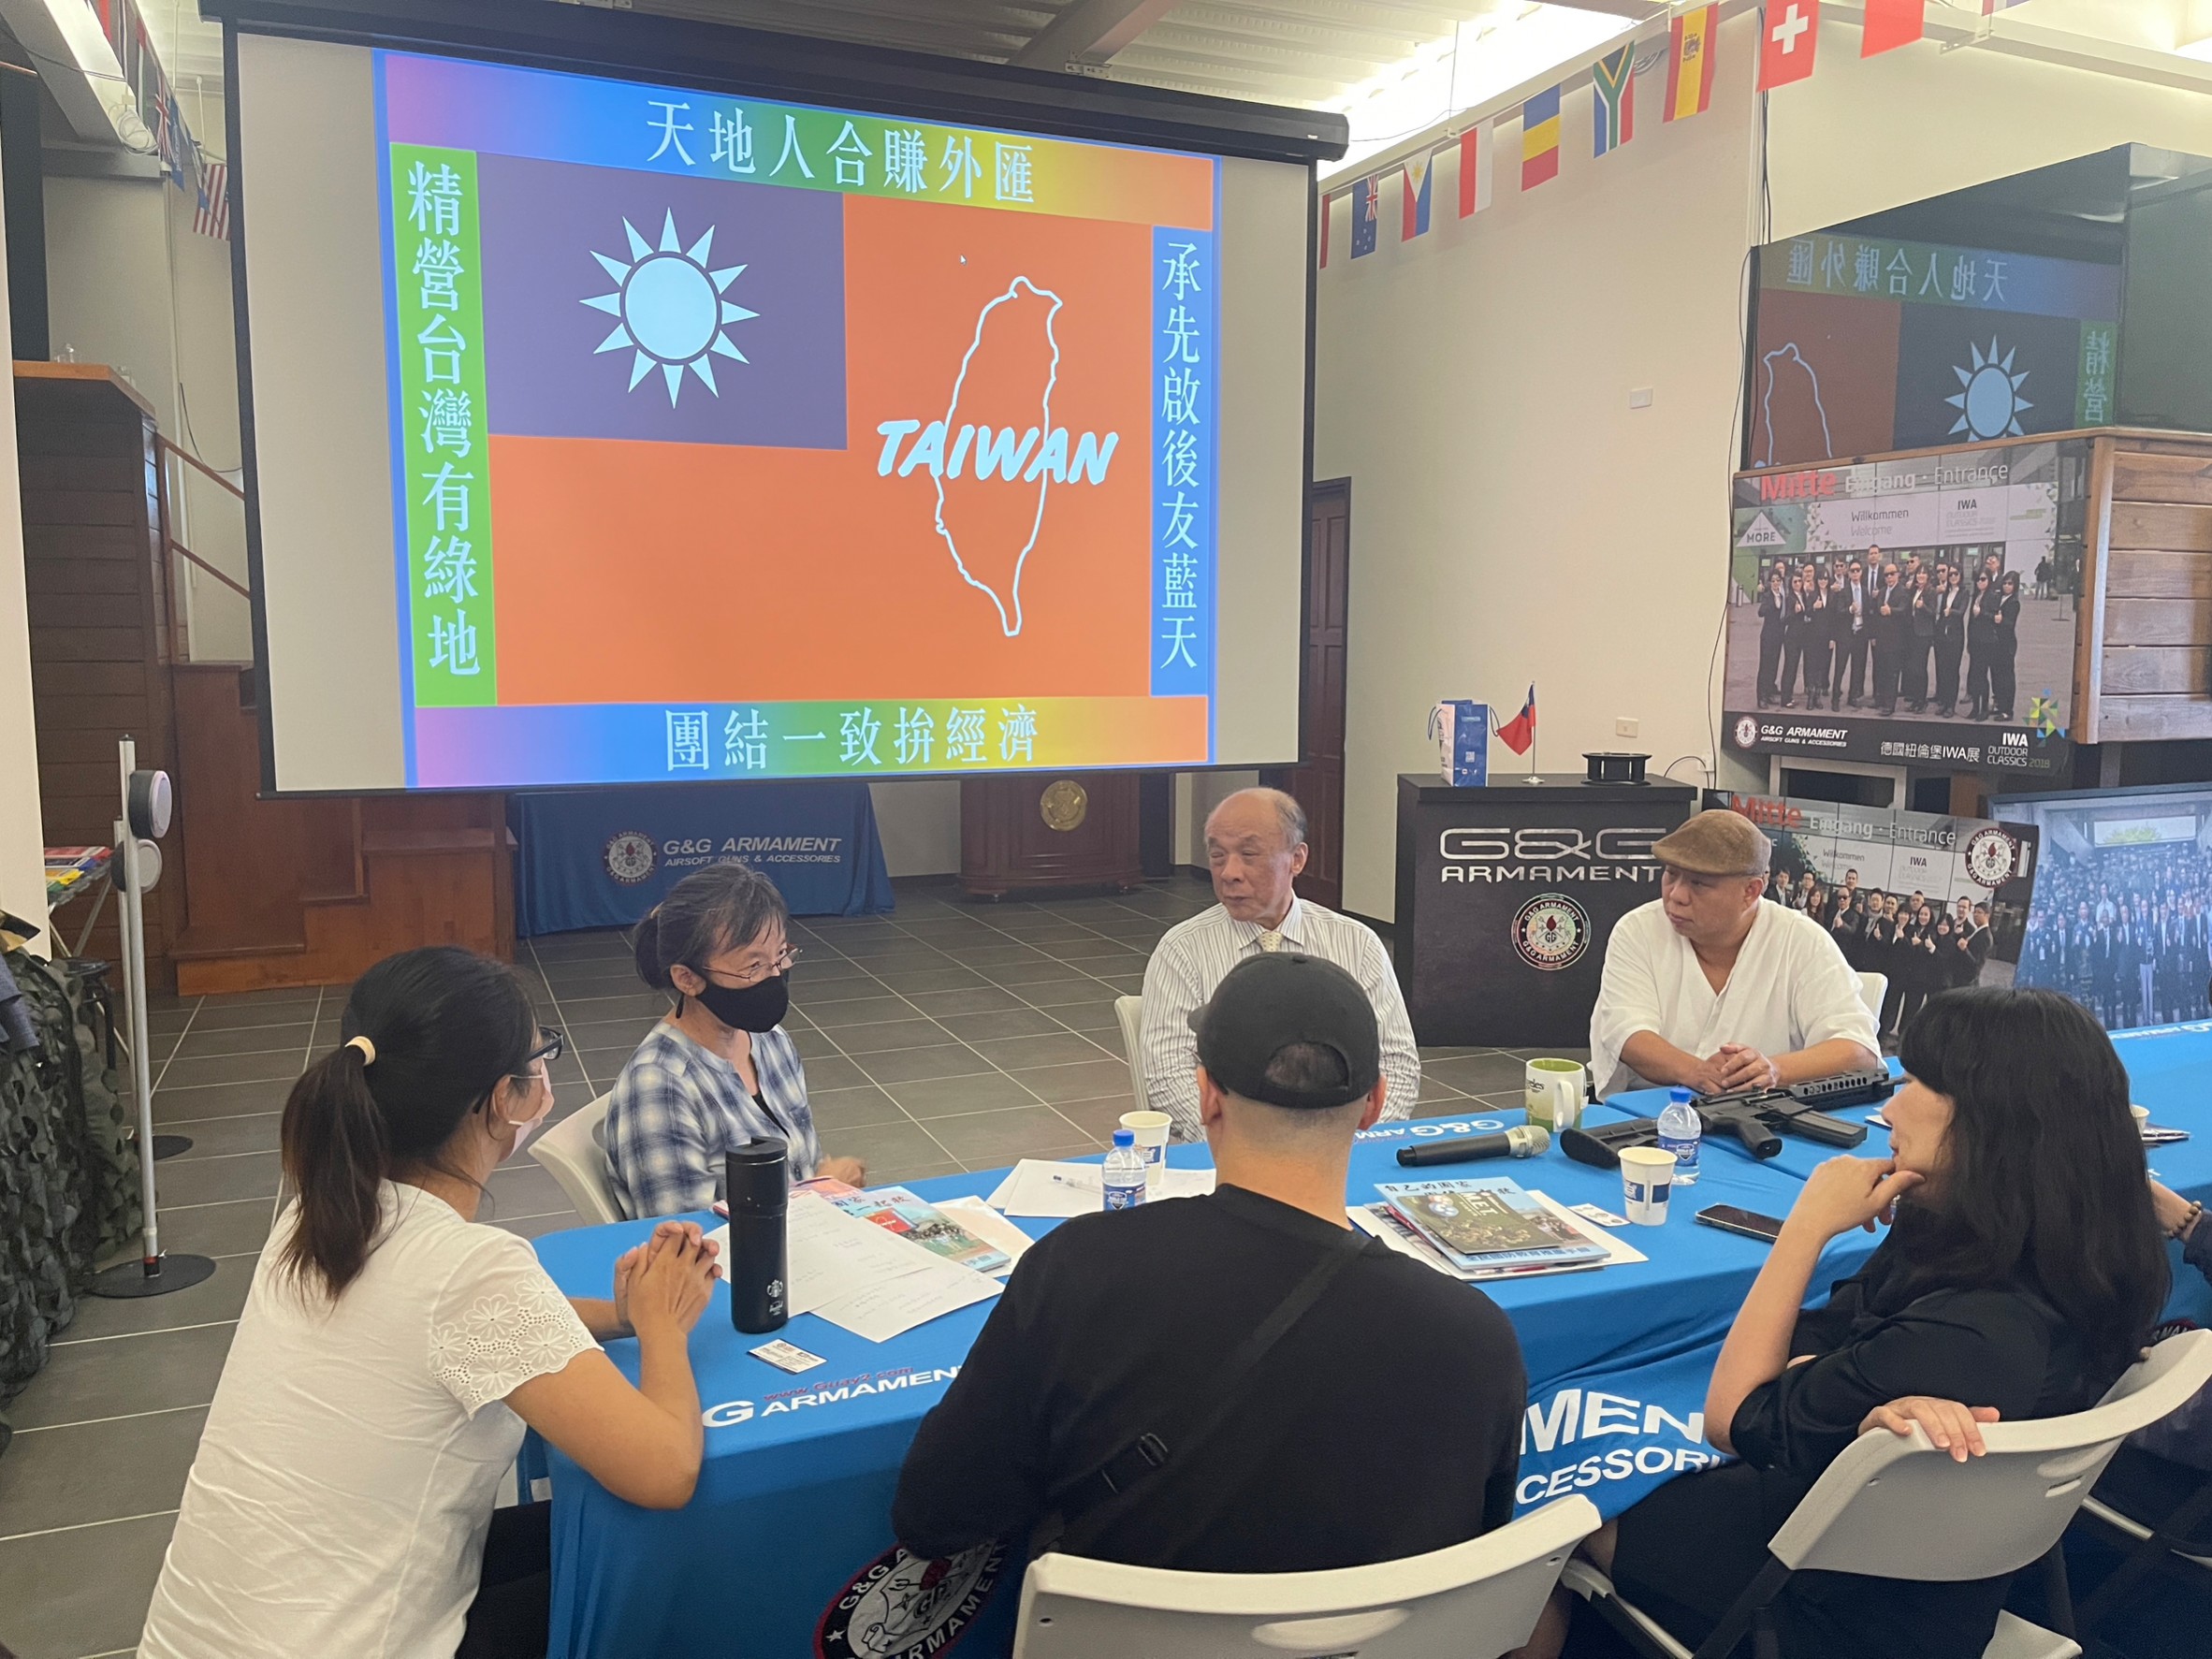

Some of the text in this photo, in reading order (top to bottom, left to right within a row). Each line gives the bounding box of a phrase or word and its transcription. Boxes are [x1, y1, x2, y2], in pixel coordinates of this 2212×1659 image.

[647, 99, 1035, 203] 天地人合賺外匯
[407, 160, 481, 676] 精營台灣有綠地
[877, 418, 1119, 487] TAIWAN
[1160, 241, 1201, 669] 承先啟後友藍天
[1760, 470, 1837, 502] Mitte
[1934, 462, 2009, 487] Entrance
[1957, 499, 1977, 510] IWA
[1851, 507, 1909, 521] Willkommen
[1746, 531, 1776, 544] MORE
[1851, 525, 1893, 537] Welcome
[1760, 724, 1848, 741] G&G ARMAMENT
[2002, 732, 2029, 747] IWA
[1881, 740, 1981, 763] 德國紐倫堡IWA展
[1987, 746, 2029, 757] OUTDOOR
[1986, 755, 2050, 768] CLASSICS 2018
[1731, 794, 1803, 828] Mitte
[1888, 822, 1957, 847] Entrance
[662, 837, 841, 855] G&G ARMAMENT
[1439, 827, 1666, 861] G&G
[664, 855, 713, 867] AIRSOFT
[766, 854, 841, 864] ACCESSORIES
[1823, 849, 1866, 863] Willkommen
[1910, 856, 1928, 867] IWA
[1441, 866, 1662, 883] ARMAMENT
[1539, 902, 1579, 922] ARMAMENT
[1536, 940, 1579, 961] ARMAMENT
[1409, 1118, 1505, 1137] G&G
[760, 1364, 962, 1418] ARMAMEN
[839, 1564, 890, 1610] G&G
